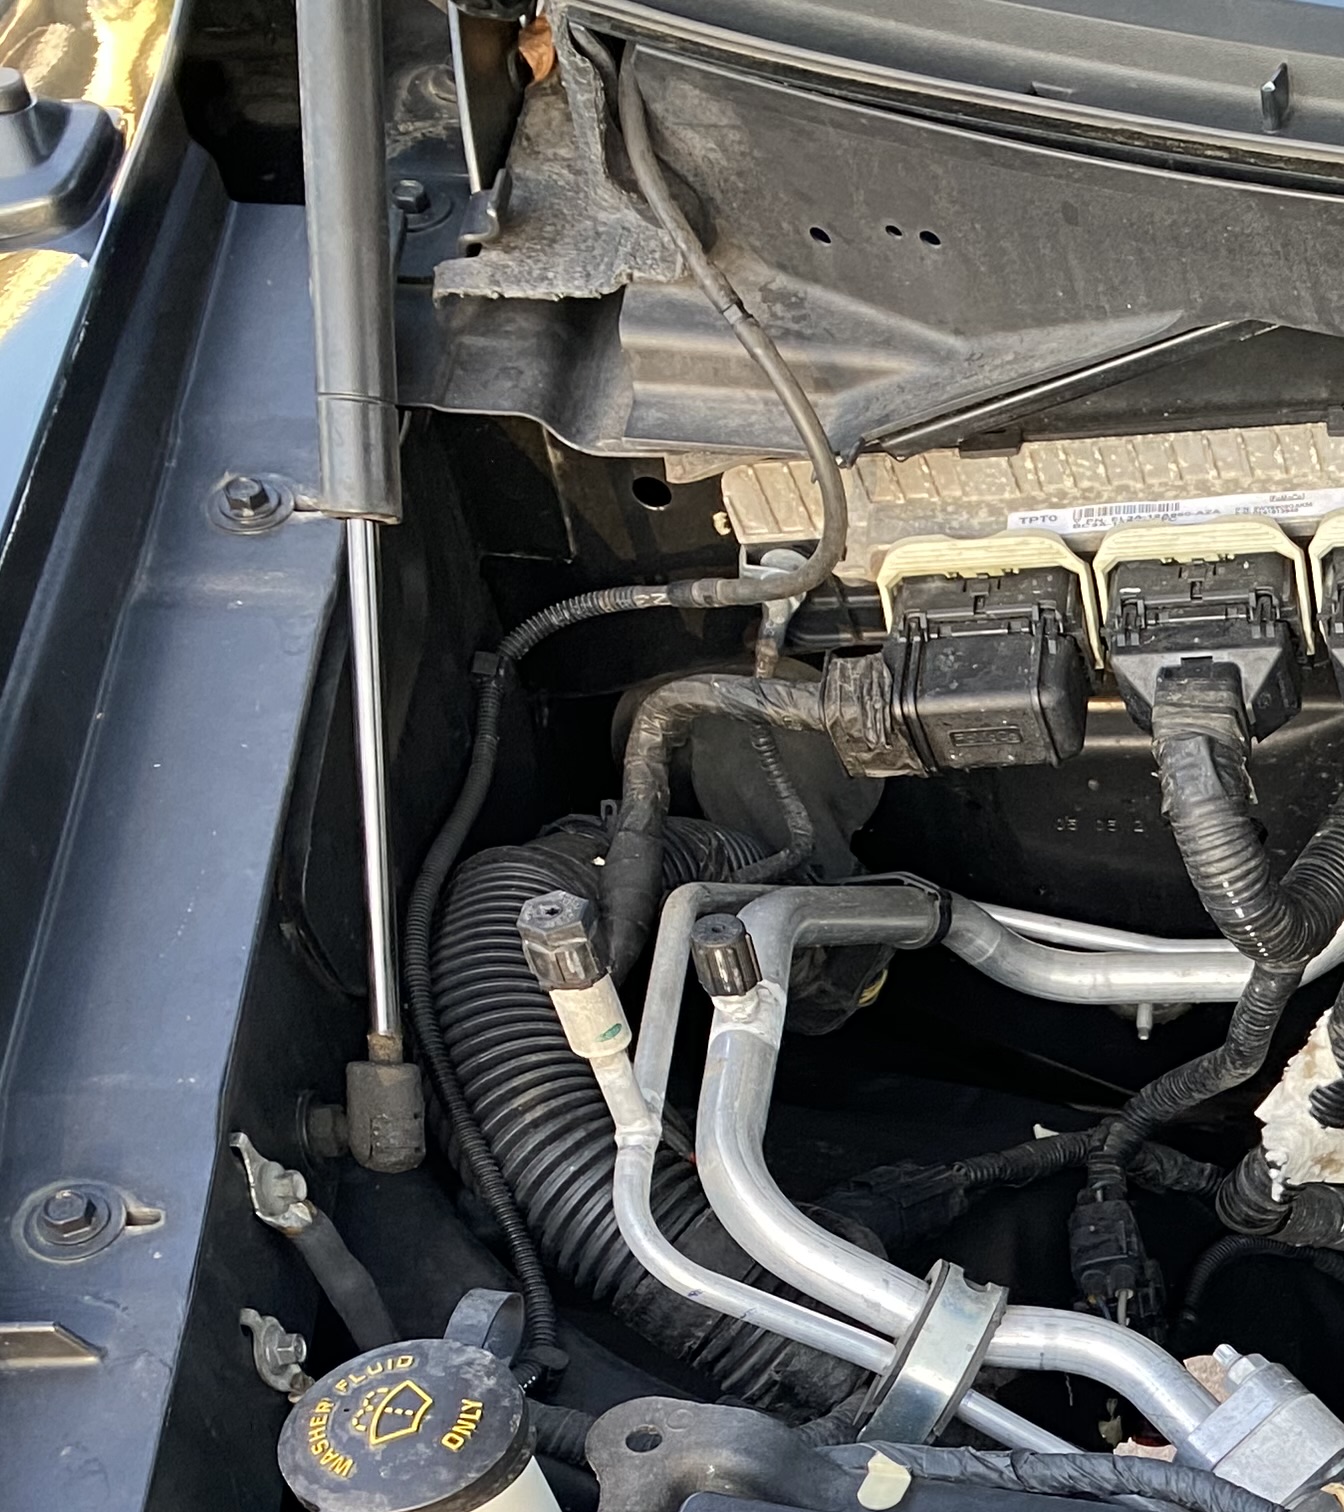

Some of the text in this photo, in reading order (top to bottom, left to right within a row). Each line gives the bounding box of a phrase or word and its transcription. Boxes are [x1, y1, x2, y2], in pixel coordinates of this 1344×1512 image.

[308, 1354, 415, 1477] WASHER FLUID
[441, 1398, 484, 1452] ONLY
